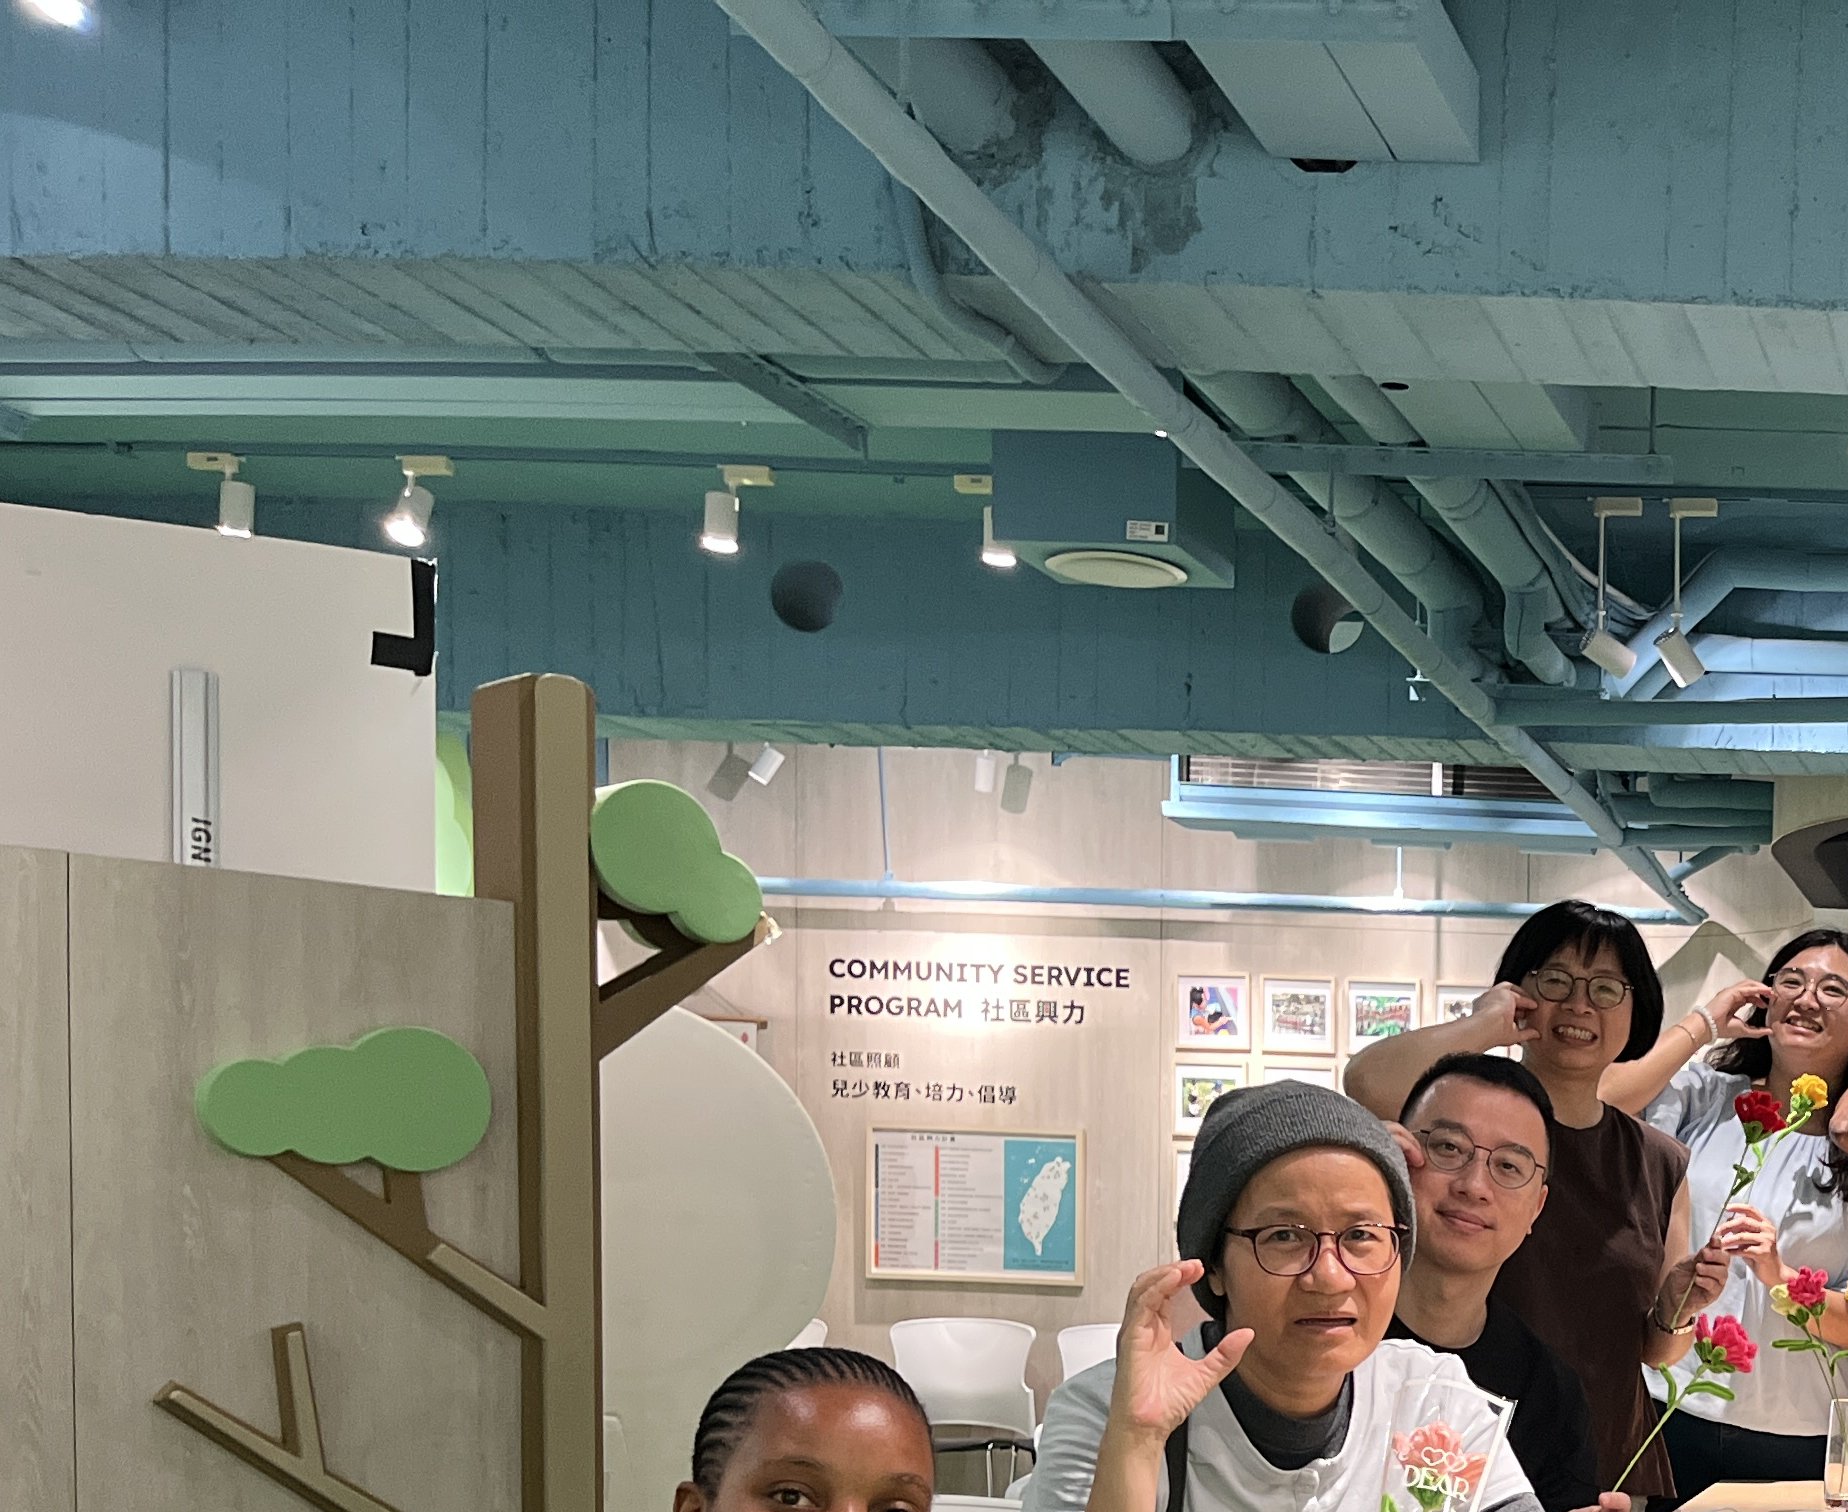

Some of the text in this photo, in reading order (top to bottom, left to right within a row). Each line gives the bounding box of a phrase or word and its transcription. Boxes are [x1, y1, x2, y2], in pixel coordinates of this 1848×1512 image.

[829, 958, 1130, 988] COMMUNITY SERVICE
[829, 994, 1085, 1025] PROGRAM 社區興力
[831, 1051, 900, 1069] 社區照顧
[1402, 1464, 1468, 1502] DEAR
